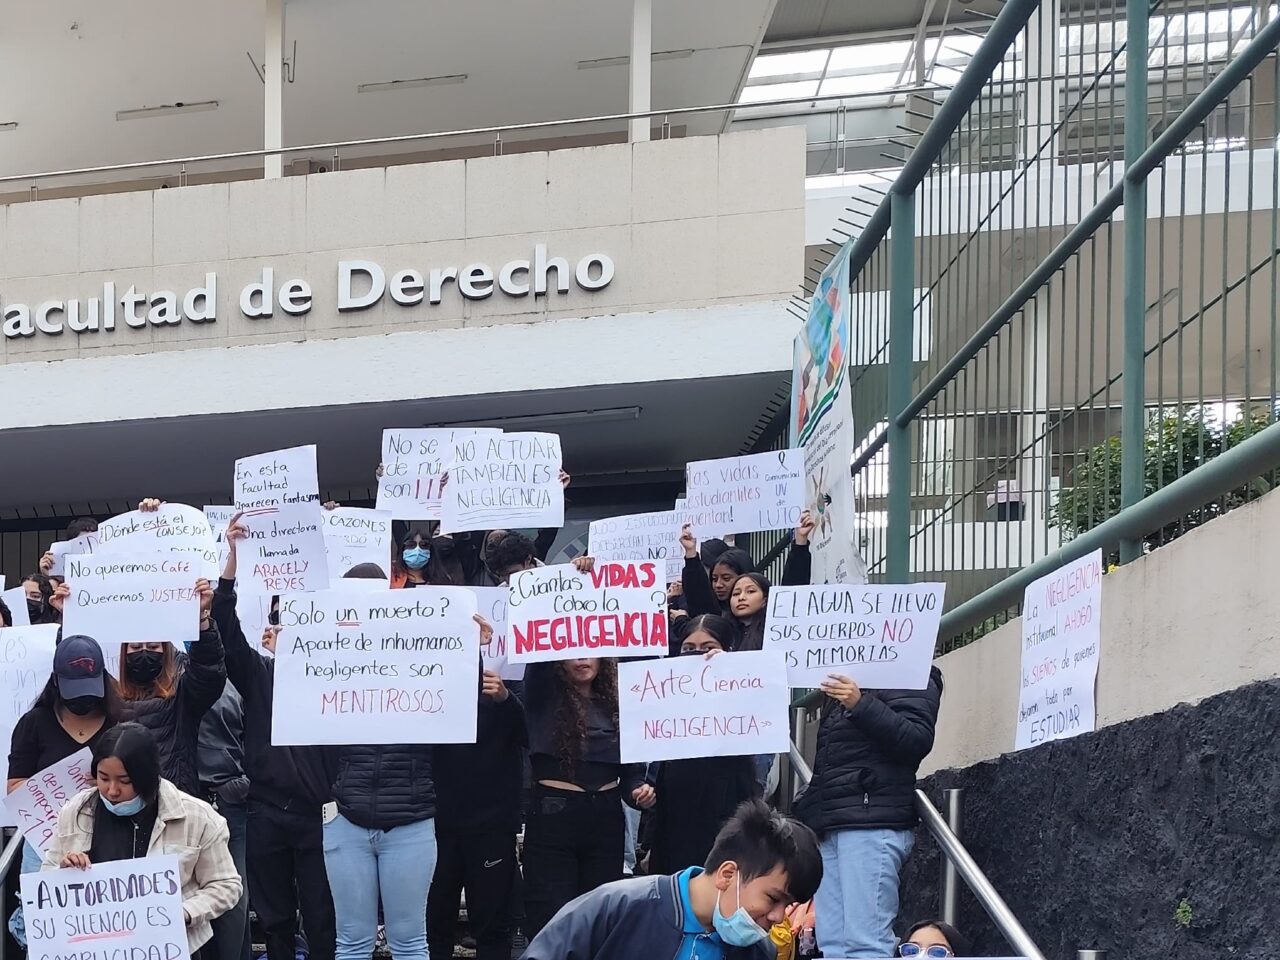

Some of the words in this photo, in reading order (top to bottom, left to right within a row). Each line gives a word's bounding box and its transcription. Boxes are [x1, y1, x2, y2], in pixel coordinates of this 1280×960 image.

[239, 267, 312, 319] de
[336, 243, 616, 313] Derecho
[388, 436, 412, 456] No
[419, 439, 439, 456] se
[455, 438, 475, 461] NO
[487, 438, 556, 461] ACTUAR
[236, 463, 253, 481] En
[259, 460, 289, 478] esta
[385, 460, 408, 477] de
[455, 460, 526, 484] TAMBIÉN
[532, 463, 551, 483] ES
[242, 480, 288, 494] Facultad
[383, 484, 410, 499] son
[775, 483, 787, 497] UV
[457, 486, 551, 510] NEGLIGENCIA
[330, 515, 387, 533] CAZONES
[759, 506, 801, 528] LUTO
[271, 520, 318, 537] directora
[259, 545, 300, 557] llamada
[70, 559, 91, 578] No
[96, 563, 158, 580] queremos
[254, 561, 309, 578] ARACELY
[590, 563, 657, 590] VIDAS
[264, 577, 305, 591] REYES
[77, 589, 145, 608] Queremos
[772, 590, 799, 619] EL
[807, 590, 853, 616] AGUA
[861, 592, 884, 615] SE
[336, 606, 359, 622] un
[513, 611, 668, 655] NEGLIGENCIA
[770, 622, 802, 642] SUS
[807, 622, 876, 641] CUERPOS
[881, 619, 914, 643] NO
[292, 632, 351, 658] Aparte
[355, 632, 372, 651] de
[806, 646, 898, 668] MEMORIAS
[410, 662, 445, 677] son
[701, 665, 765, 693] Ciencia
[1030, 703, 1080, 744] ESTUDIAR
[32, 917, 56, 940] SU
[65, 909, 137, 938] SILENCIO
[146, 905, 171, 928] ES
